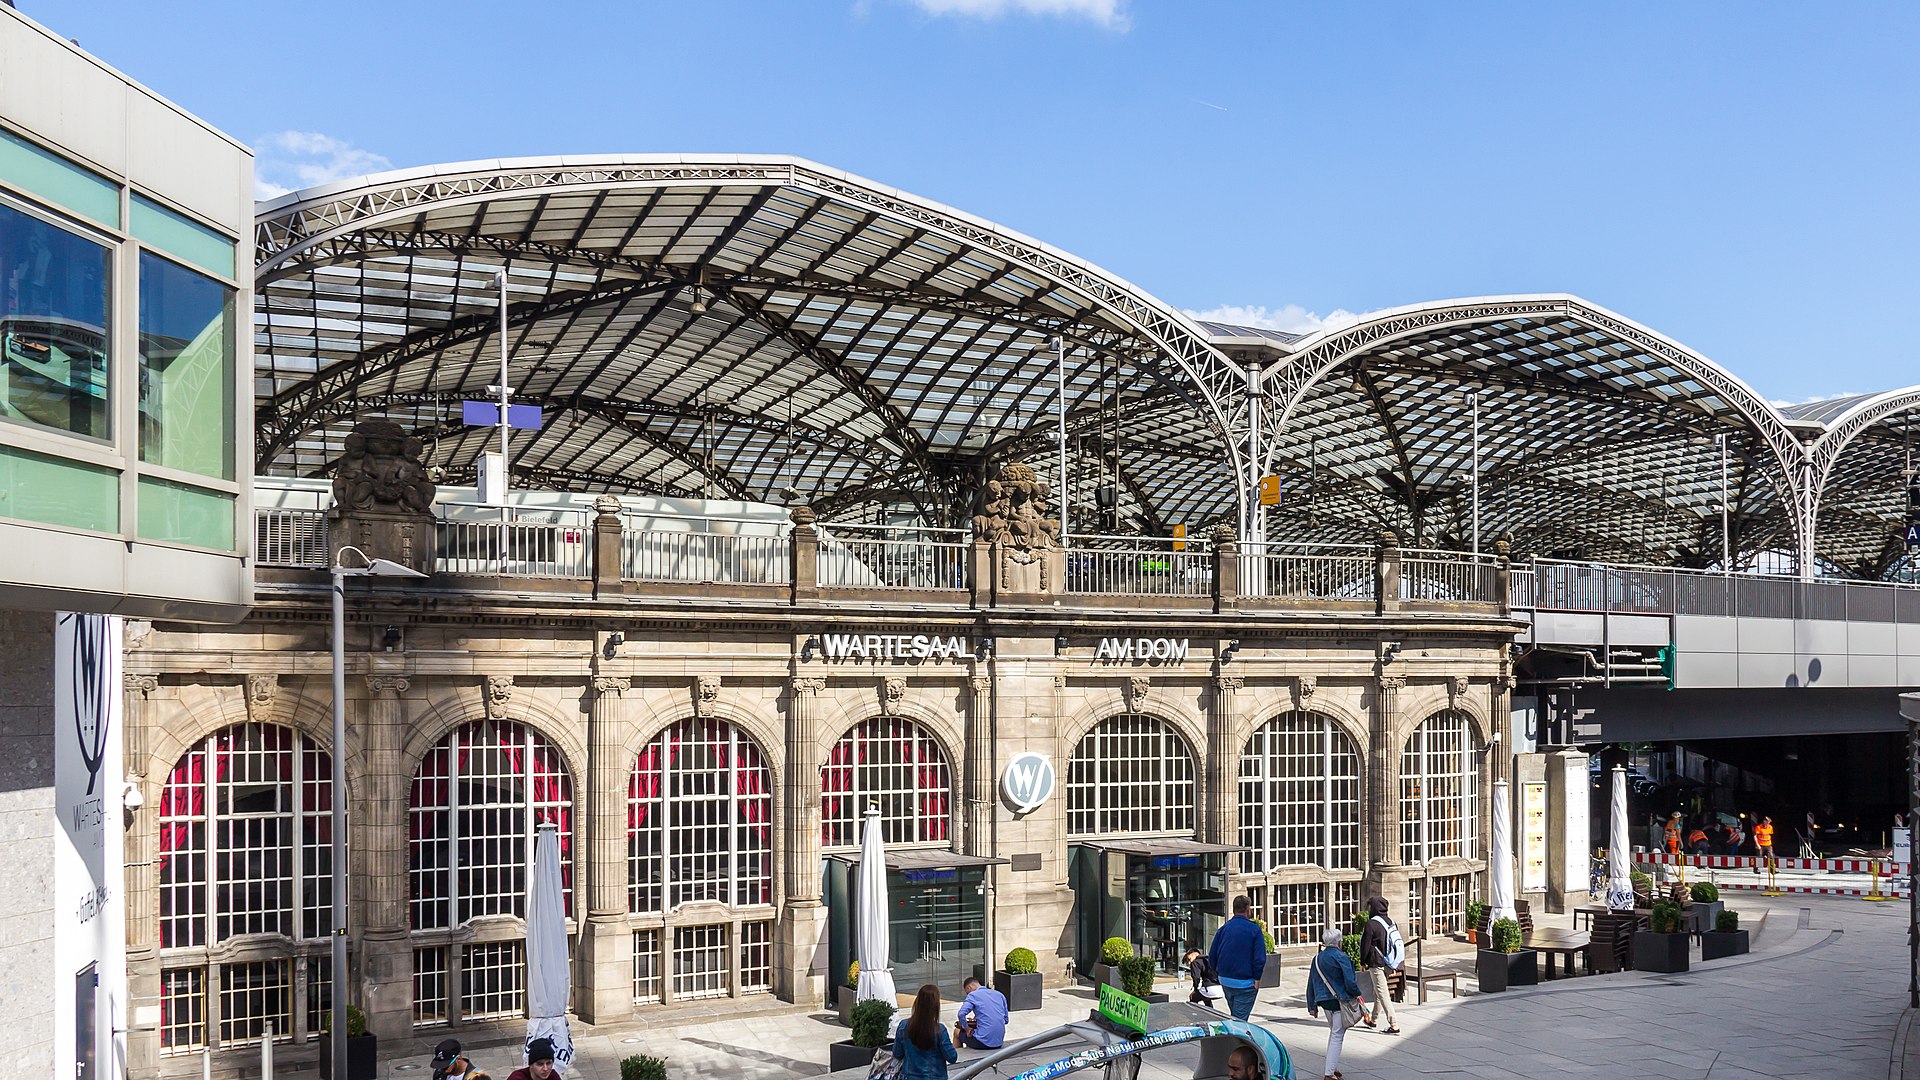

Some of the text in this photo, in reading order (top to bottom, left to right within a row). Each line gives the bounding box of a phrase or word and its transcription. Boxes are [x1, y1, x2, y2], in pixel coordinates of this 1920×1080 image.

[521, 515, 558, 524] Bielefeld
[1907, 526, 1918, 540] A
[823, 634, 975, 657] WARTESAAL
[1096, 638, 1189, 659] AM DOM
[1100, 990, 1147, 1026] PAUSENTAXI
[1087, 1049, 1105, 1061] aus
